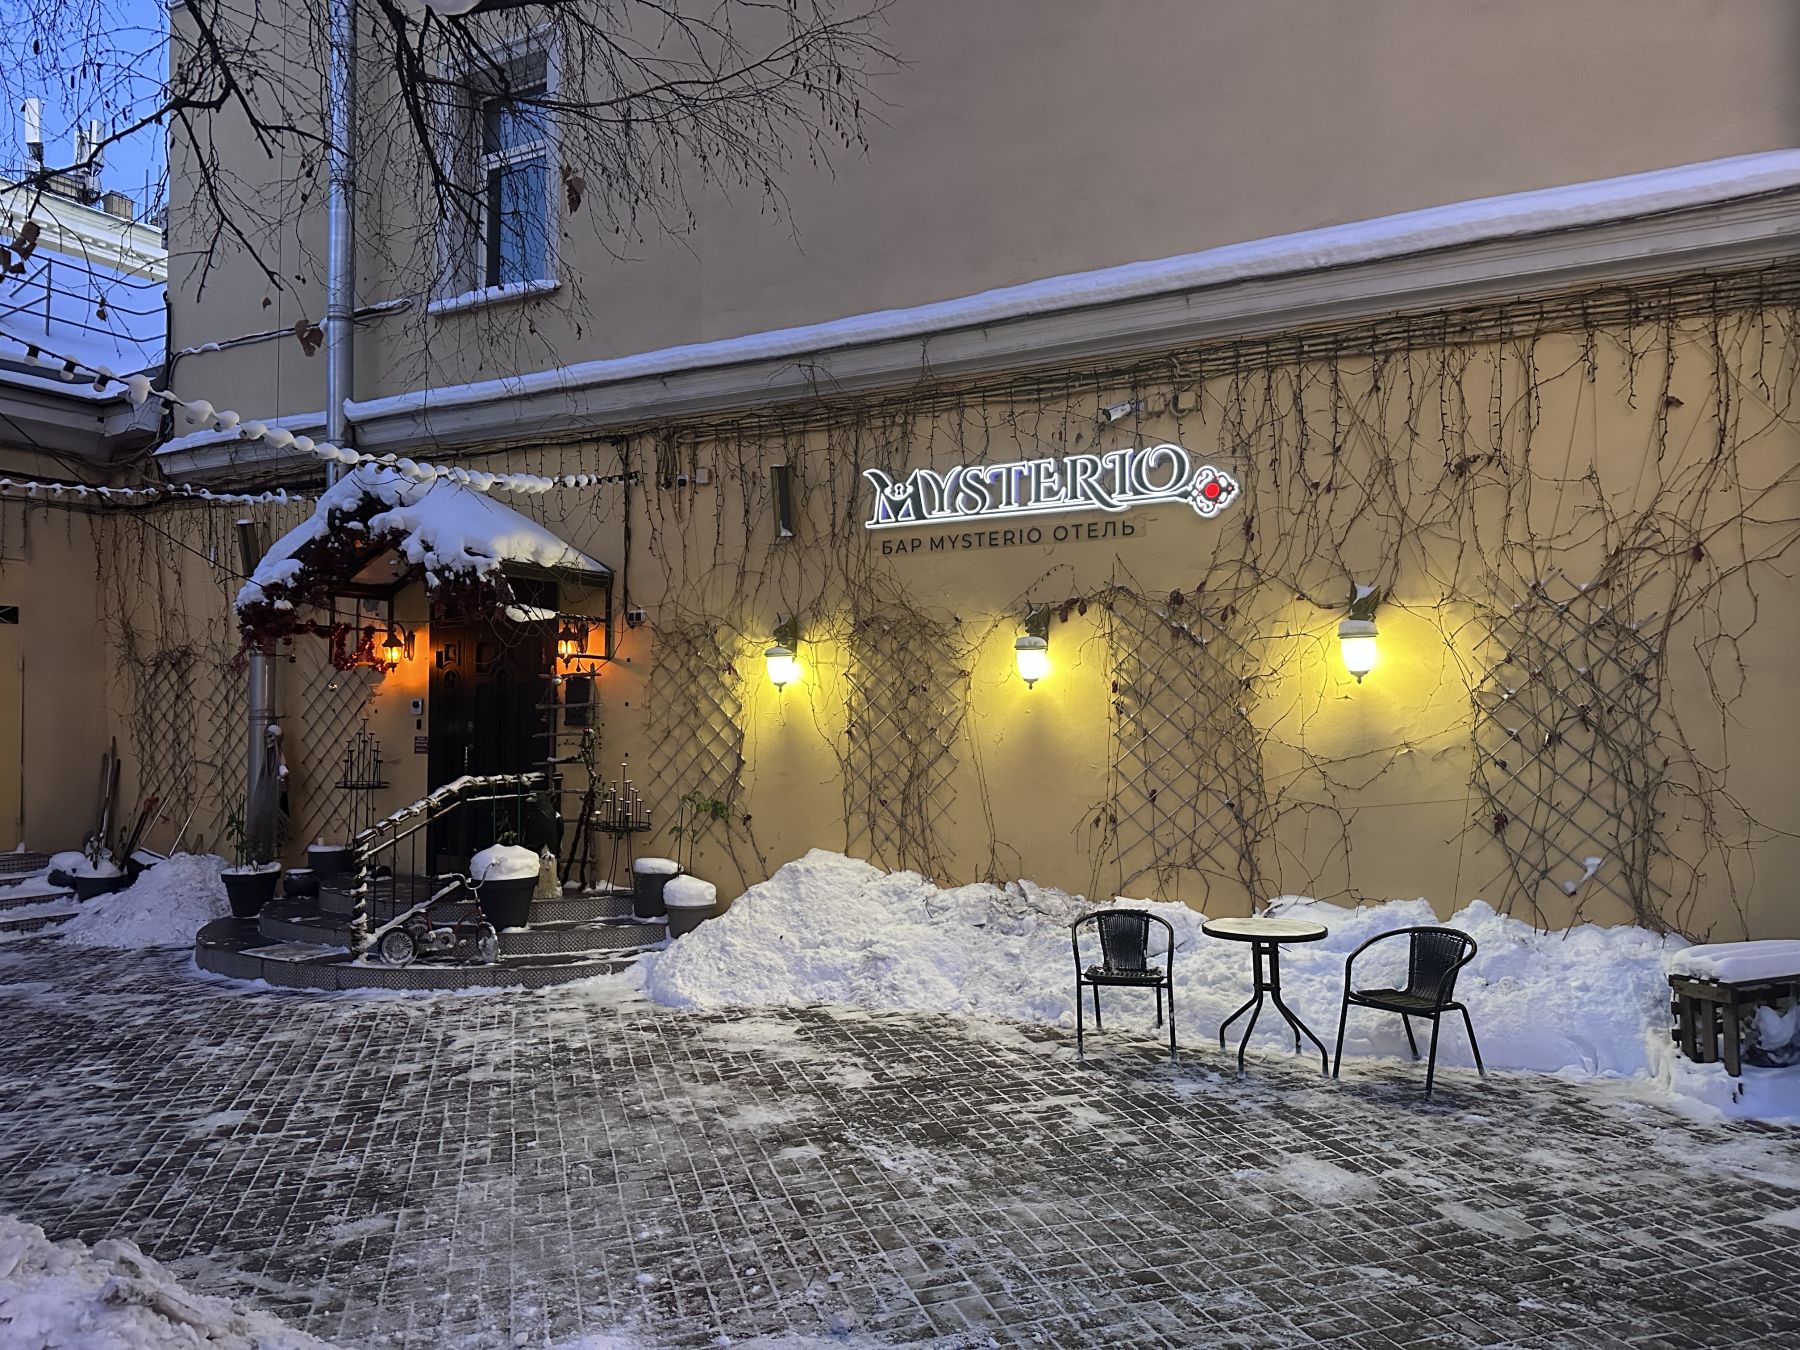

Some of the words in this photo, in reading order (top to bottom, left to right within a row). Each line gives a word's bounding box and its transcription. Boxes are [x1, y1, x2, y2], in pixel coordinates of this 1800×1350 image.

[863, 444, 1192, 526] MYSTERIO
[882, 538, 922, 555] БАР
[930, 527, 1042, 551] MYSTERIO
[1053, 520, 1135, 541] ОТЕЛЬ
